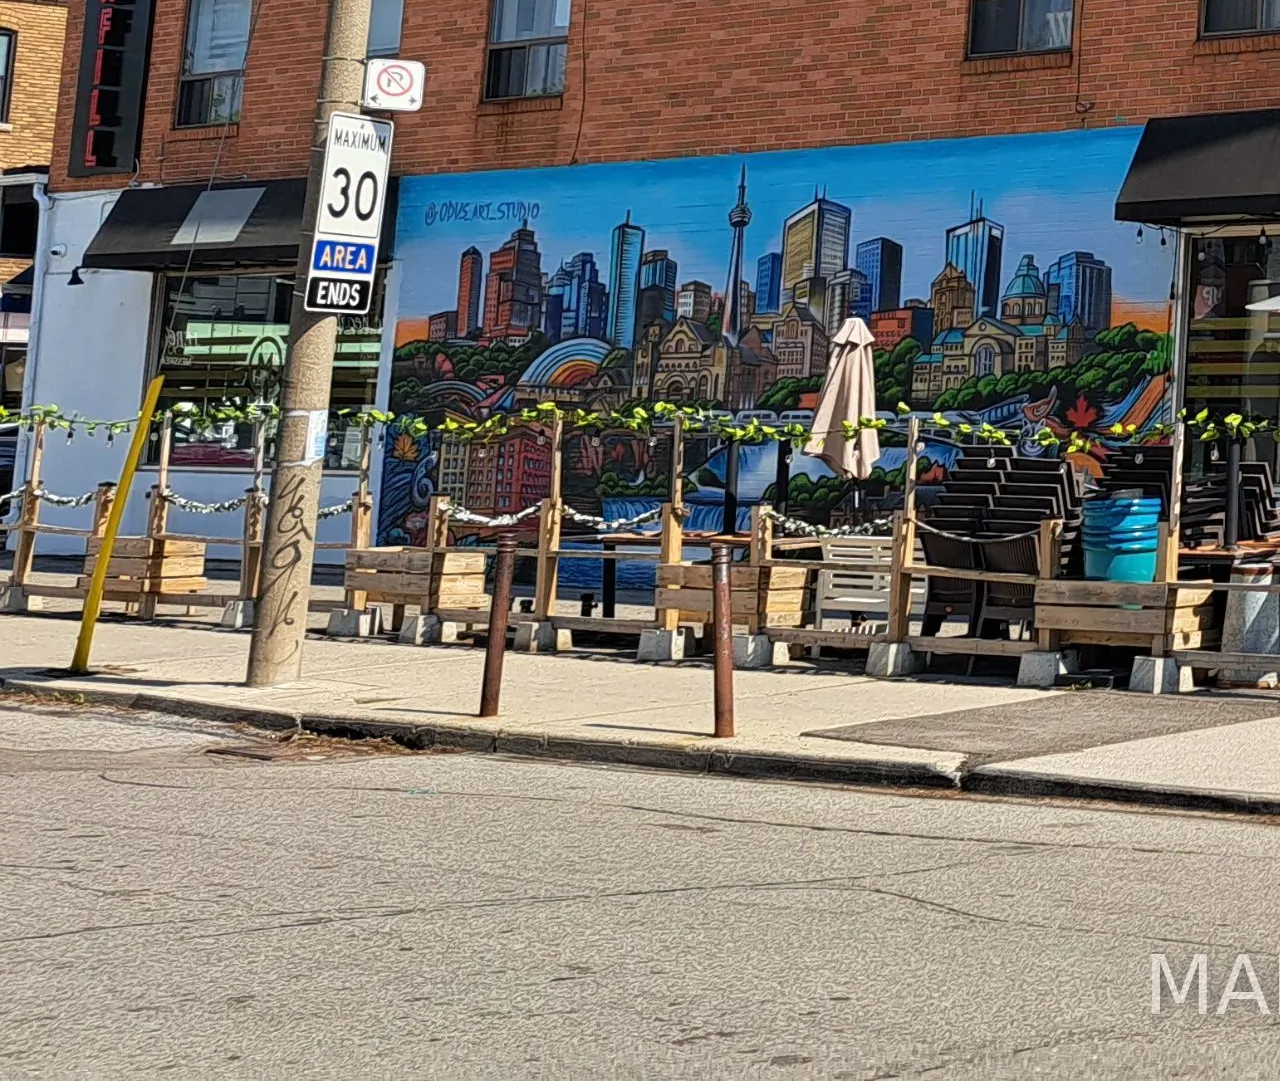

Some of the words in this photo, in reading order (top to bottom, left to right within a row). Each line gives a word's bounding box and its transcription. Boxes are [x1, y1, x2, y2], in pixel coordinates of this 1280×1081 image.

[333, 128, 387, 153] MAXIMUM
[327, 167, 378, 221] 30
[319, 244, 368, 270] AREA
[316, 282, 361, 306] ENDS
